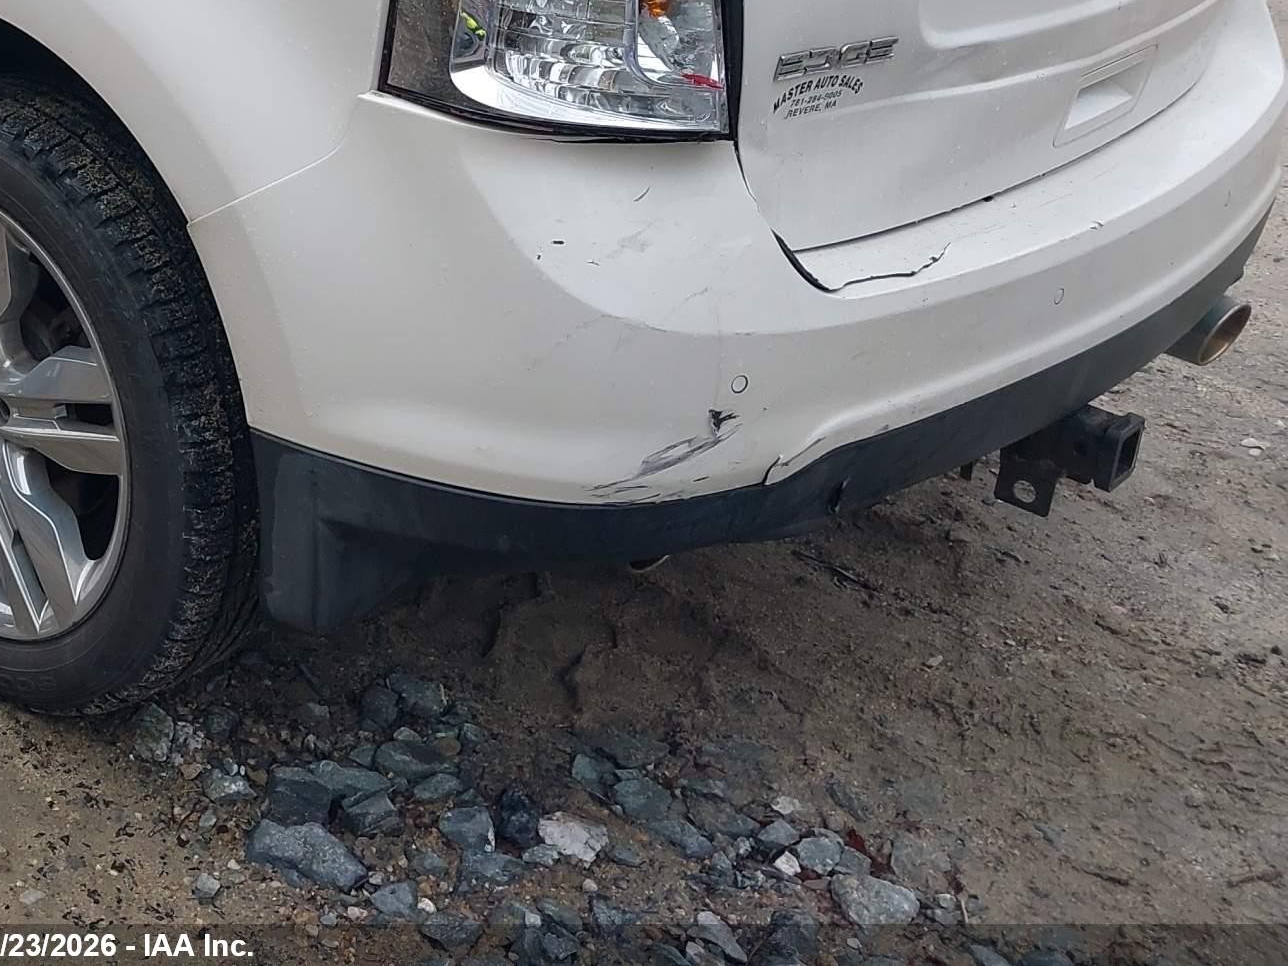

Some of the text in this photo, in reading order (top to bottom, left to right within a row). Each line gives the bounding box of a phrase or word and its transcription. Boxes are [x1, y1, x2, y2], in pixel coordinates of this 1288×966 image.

[773, 36, 899, 81] EDGE
[772, 74, 864, 115] MASTER AUTO SALES
[824, 99, 838, 111] MA
